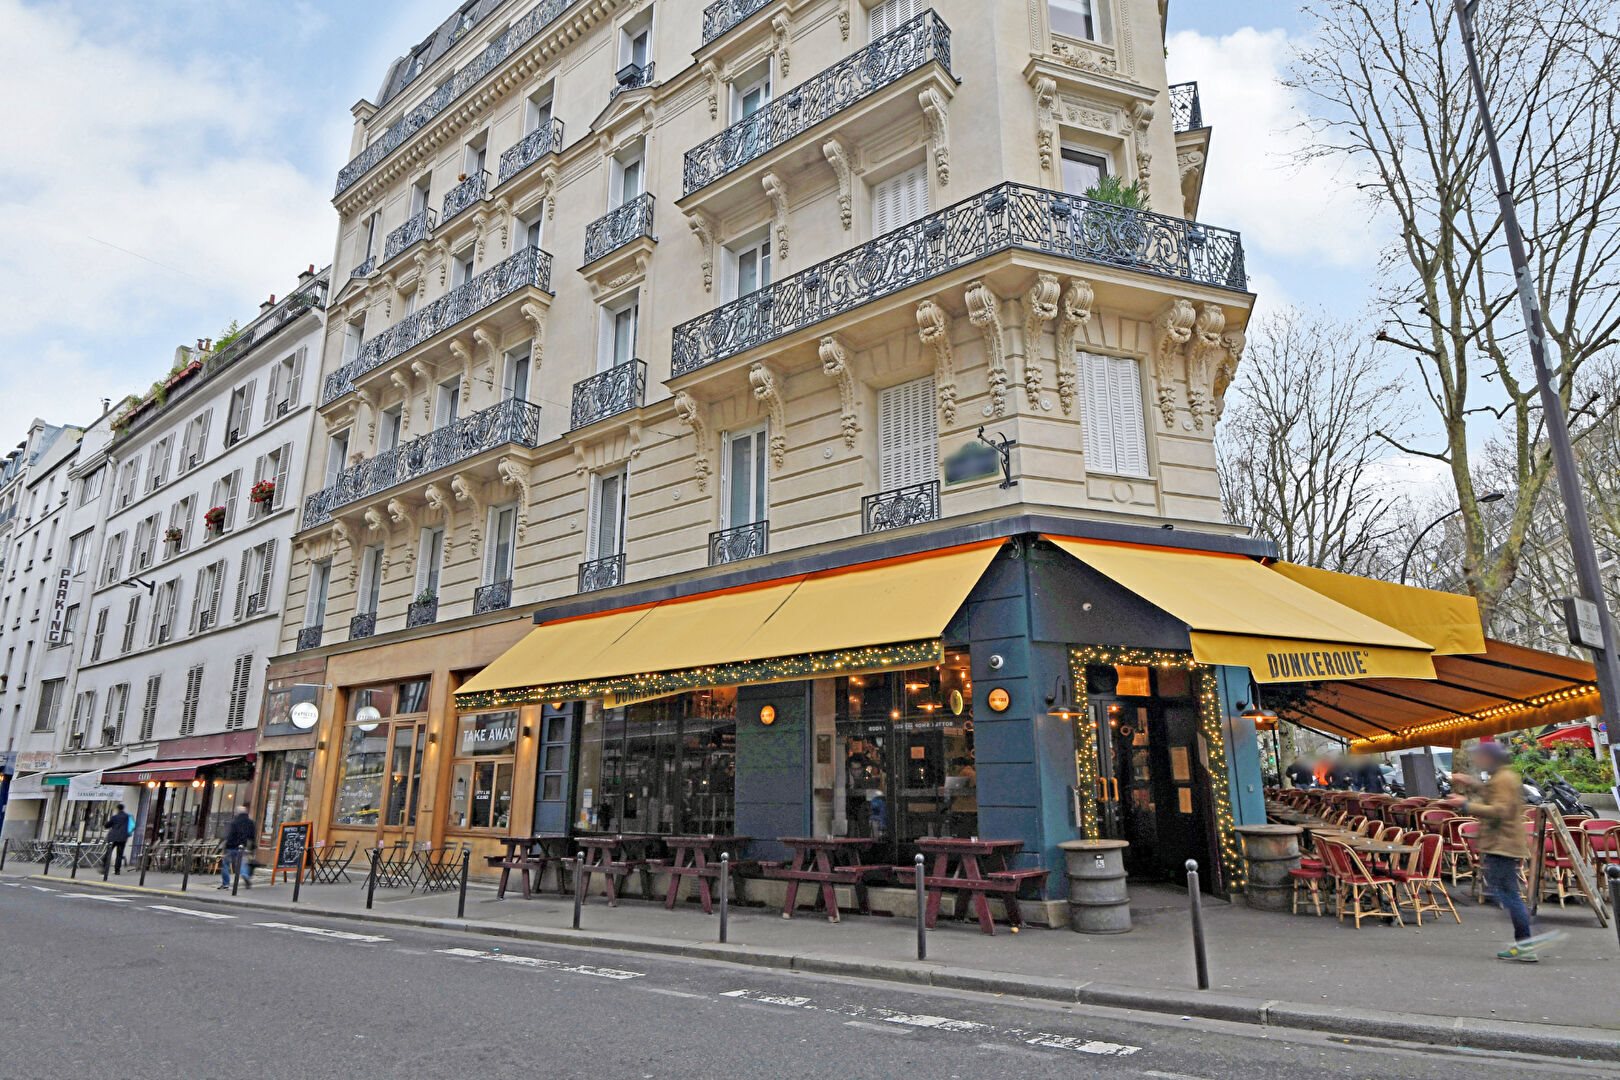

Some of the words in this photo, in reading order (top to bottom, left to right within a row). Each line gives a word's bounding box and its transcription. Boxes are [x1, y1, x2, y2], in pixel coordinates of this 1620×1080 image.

[49, 569, 71, 641] PARKING
[464, 729, 487, 741] TAKE
[488, 727, 515, 740] AWAY
